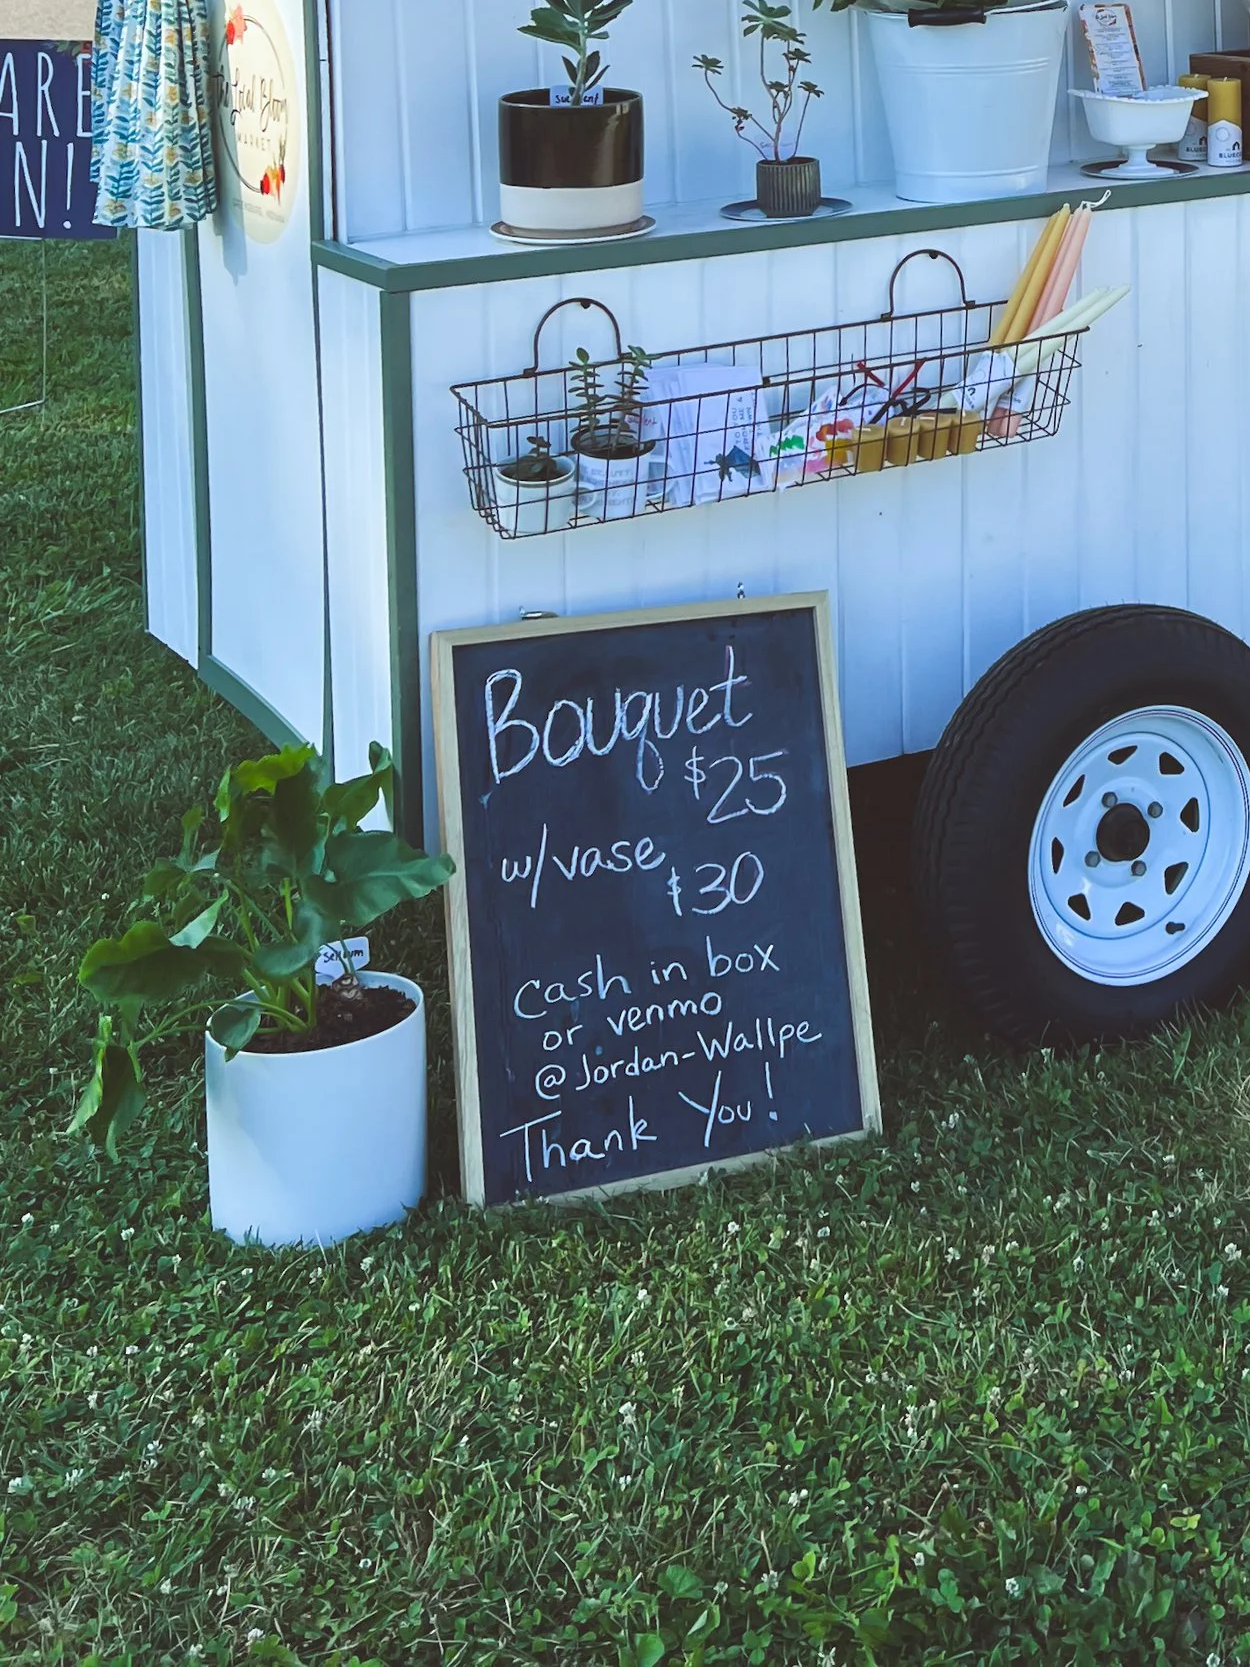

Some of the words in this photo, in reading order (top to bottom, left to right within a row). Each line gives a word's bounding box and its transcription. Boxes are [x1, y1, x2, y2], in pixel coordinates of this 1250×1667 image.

[485, 645, 754, 794] Bouquet
[684, 746, 789, 824] $25
[501, 822, 666, 909] w/vase
[667, 851, 764, 916] $30
[651, 958, 688, 985] in
[706, 936, 780, 979] box
[543, 1022, 583, 1052] or
[606, 992, 722, 1037] venmo
[500, 1095, 658, 1183] Thank
[678, 1062, 779, 1148] You!
